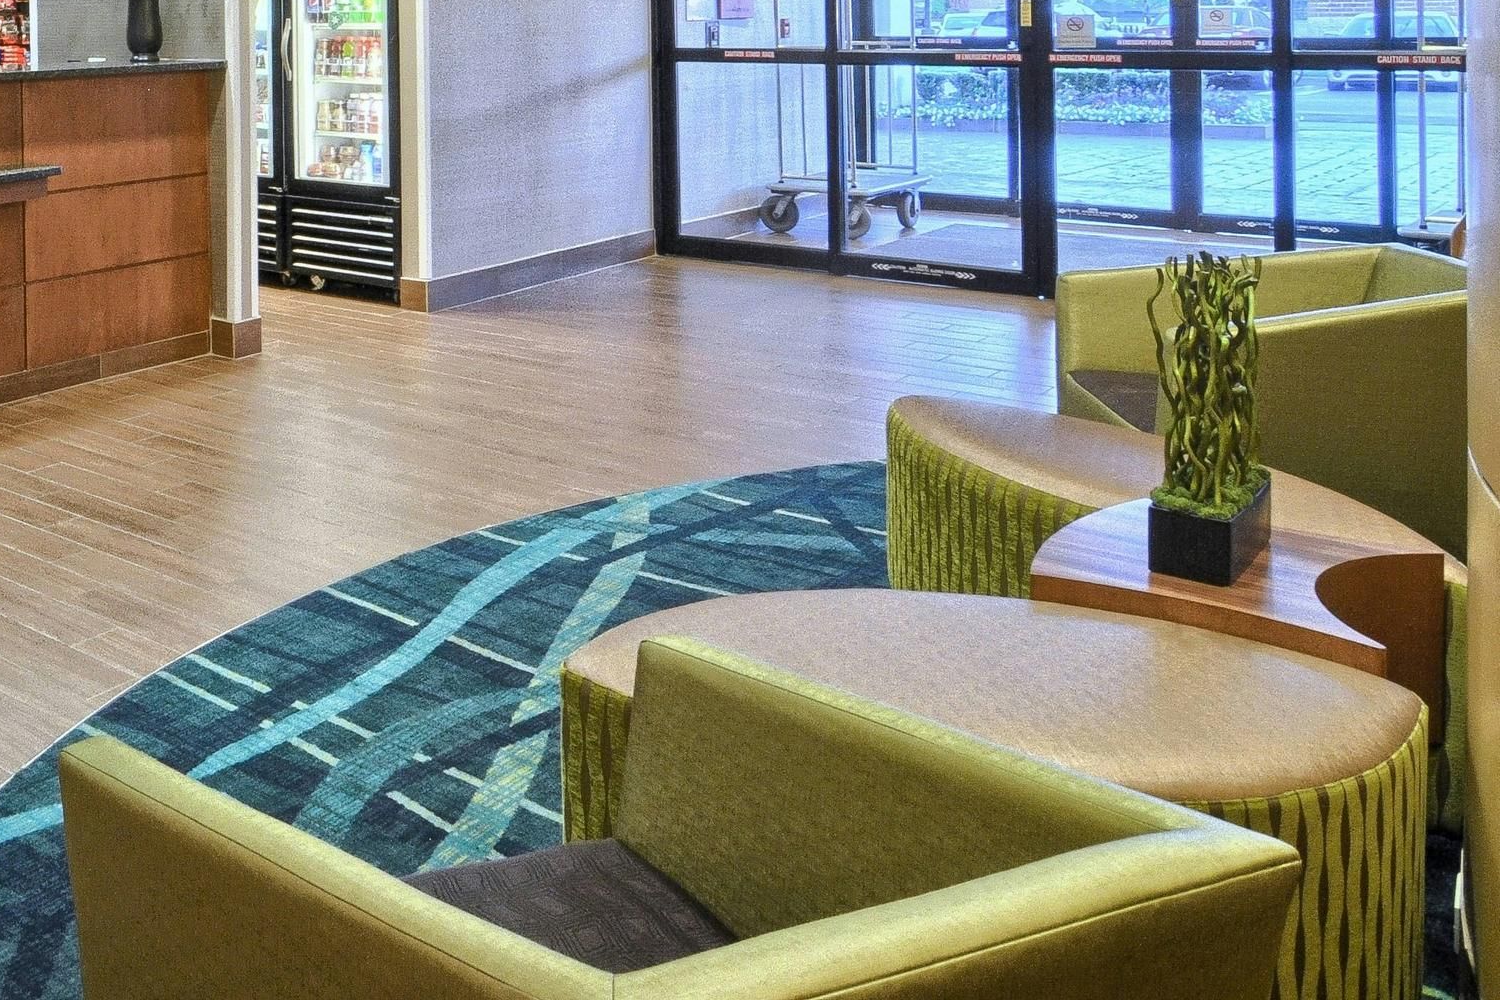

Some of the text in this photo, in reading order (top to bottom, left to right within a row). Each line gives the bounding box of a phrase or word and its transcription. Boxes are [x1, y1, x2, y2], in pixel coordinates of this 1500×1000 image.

[1377, 55, 1461, 64] CAUTION STAND BACK
